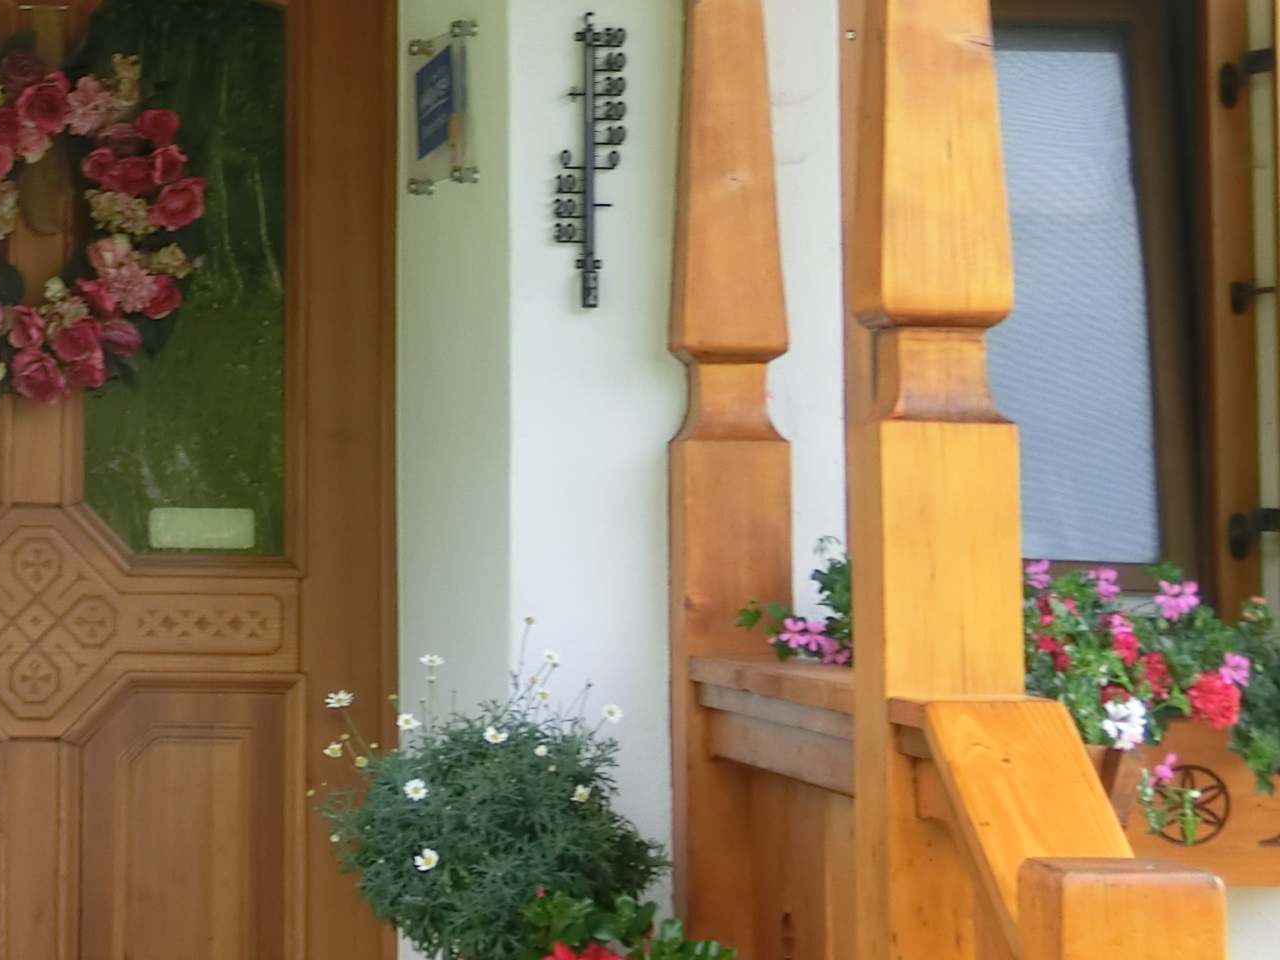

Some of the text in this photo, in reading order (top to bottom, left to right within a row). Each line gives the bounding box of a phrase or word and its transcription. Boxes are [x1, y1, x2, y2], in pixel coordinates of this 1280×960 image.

[604, 76, 626, 93] 30
[604, 101, 626, 118] 20
[606, 125, 626, 143] 10
[555, 174, 576, 191] 10
[554, 198, 576, 216] 20
[554, 223, 576, 241] 30
